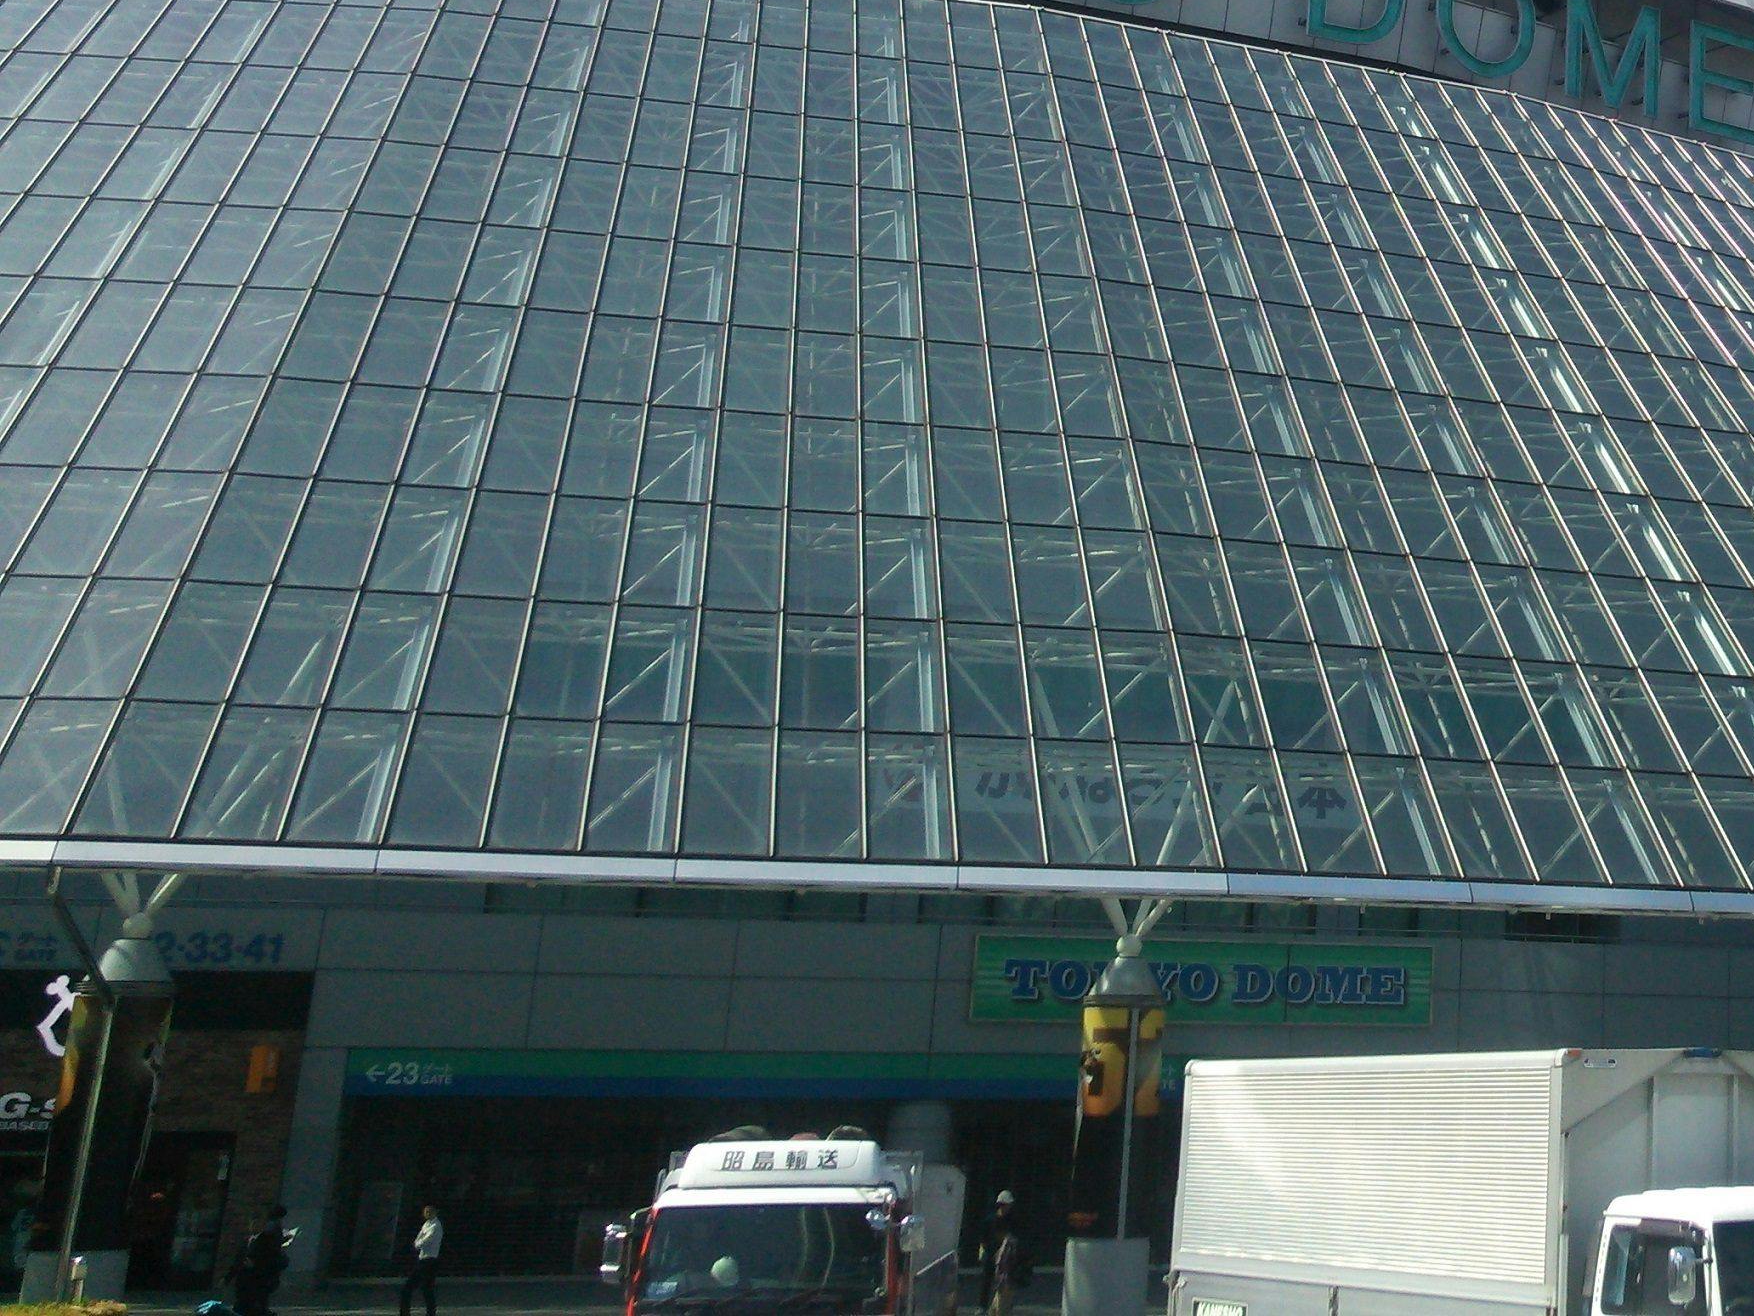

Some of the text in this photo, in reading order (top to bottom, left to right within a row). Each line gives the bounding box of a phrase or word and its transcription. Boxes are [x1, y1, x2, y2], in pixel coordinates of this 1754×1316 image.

[1004, 959, 1405, 1005] TOYO DOME
[386, 1062, 419, 1084] 23
[722, 1149, 839, 1171] 昭島輸送
